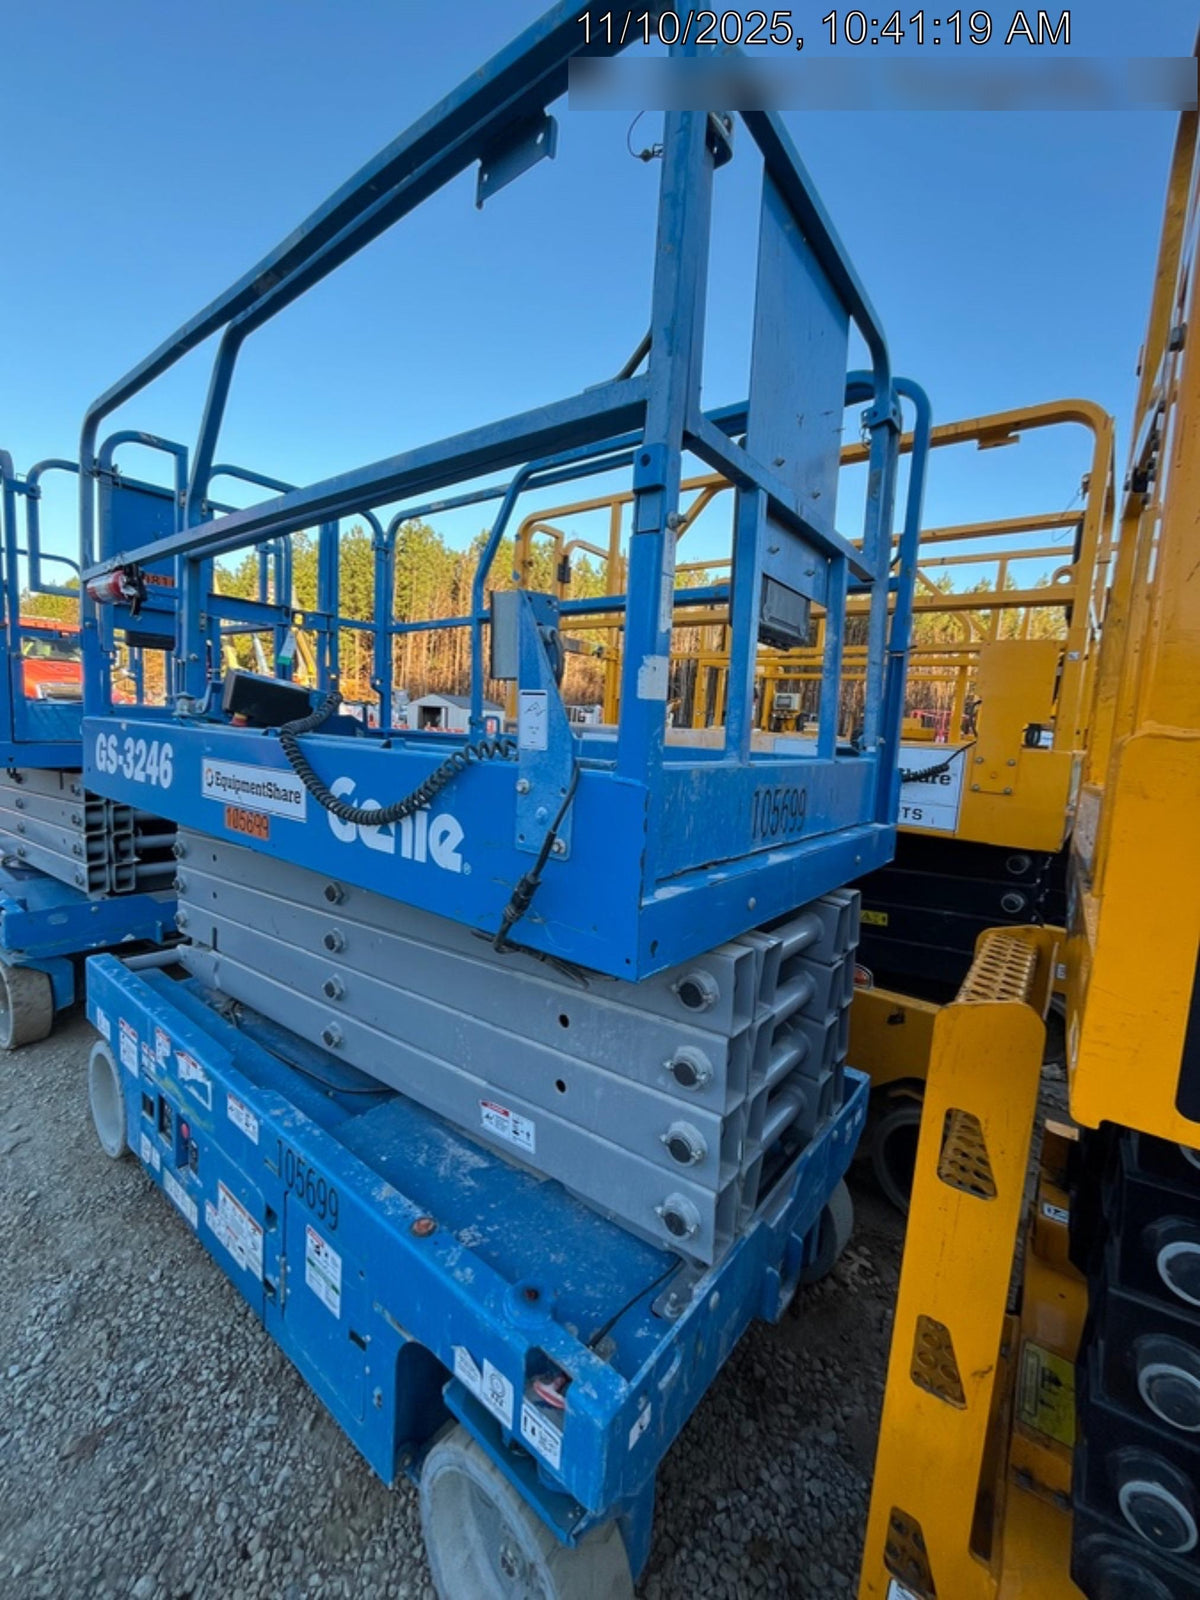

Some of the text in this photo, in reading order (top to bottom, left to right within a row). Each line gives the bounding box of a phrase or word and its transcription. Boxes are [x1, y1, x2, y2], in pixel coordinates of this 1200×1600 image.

[95, 732, 173, 789] GS-3246
[215, 770, 301, 804] EquipmentShare
[752, 788, 806, 840] 105699
[277, 1139, 339, 1231] 105699
